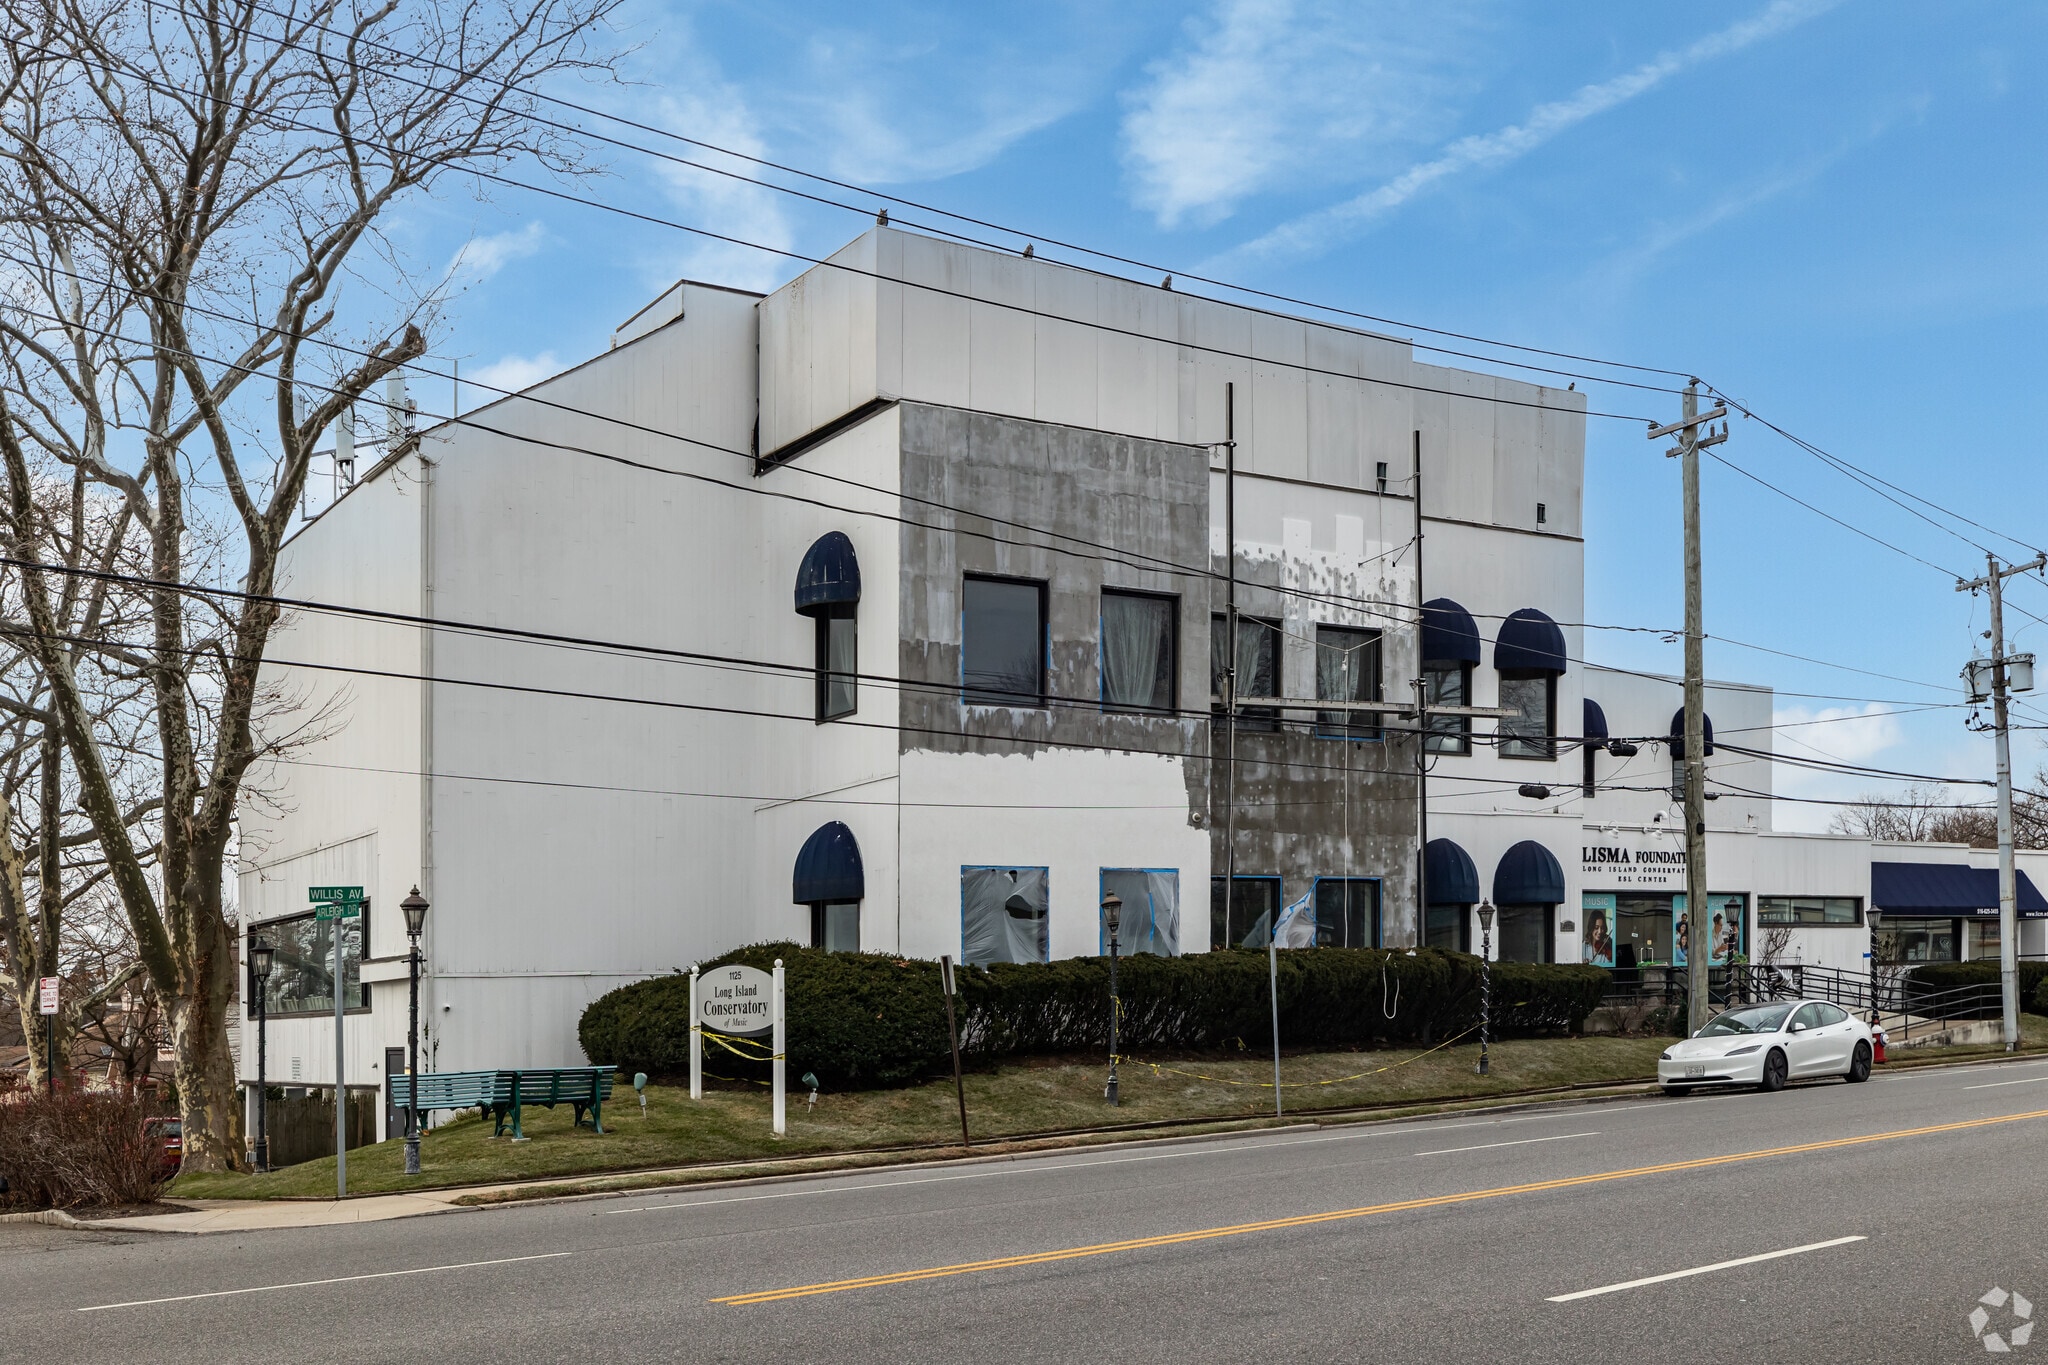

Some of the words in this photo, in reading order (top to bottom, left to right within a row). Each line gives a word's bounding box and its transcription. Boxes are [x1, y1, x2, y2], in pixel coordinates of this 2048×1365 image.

[1582, 847, 1630, 862] LISMA
[311, 889, 343, 899] WILLIS
[1584, 897, 1609, 906] MUSIC
[317, 906, 344, 917] ARLEIGH
[348, 905, 357, 914] DR
[729, 971, 741, 980] 1125
[714, 987, 732, 999] Long
[735, 984, 757, 996] Island
[704, 1000, 768, 1016] Conservatory
[724, 1018, 730, 1028] of
[732, 1018, 747, 1026] Music
